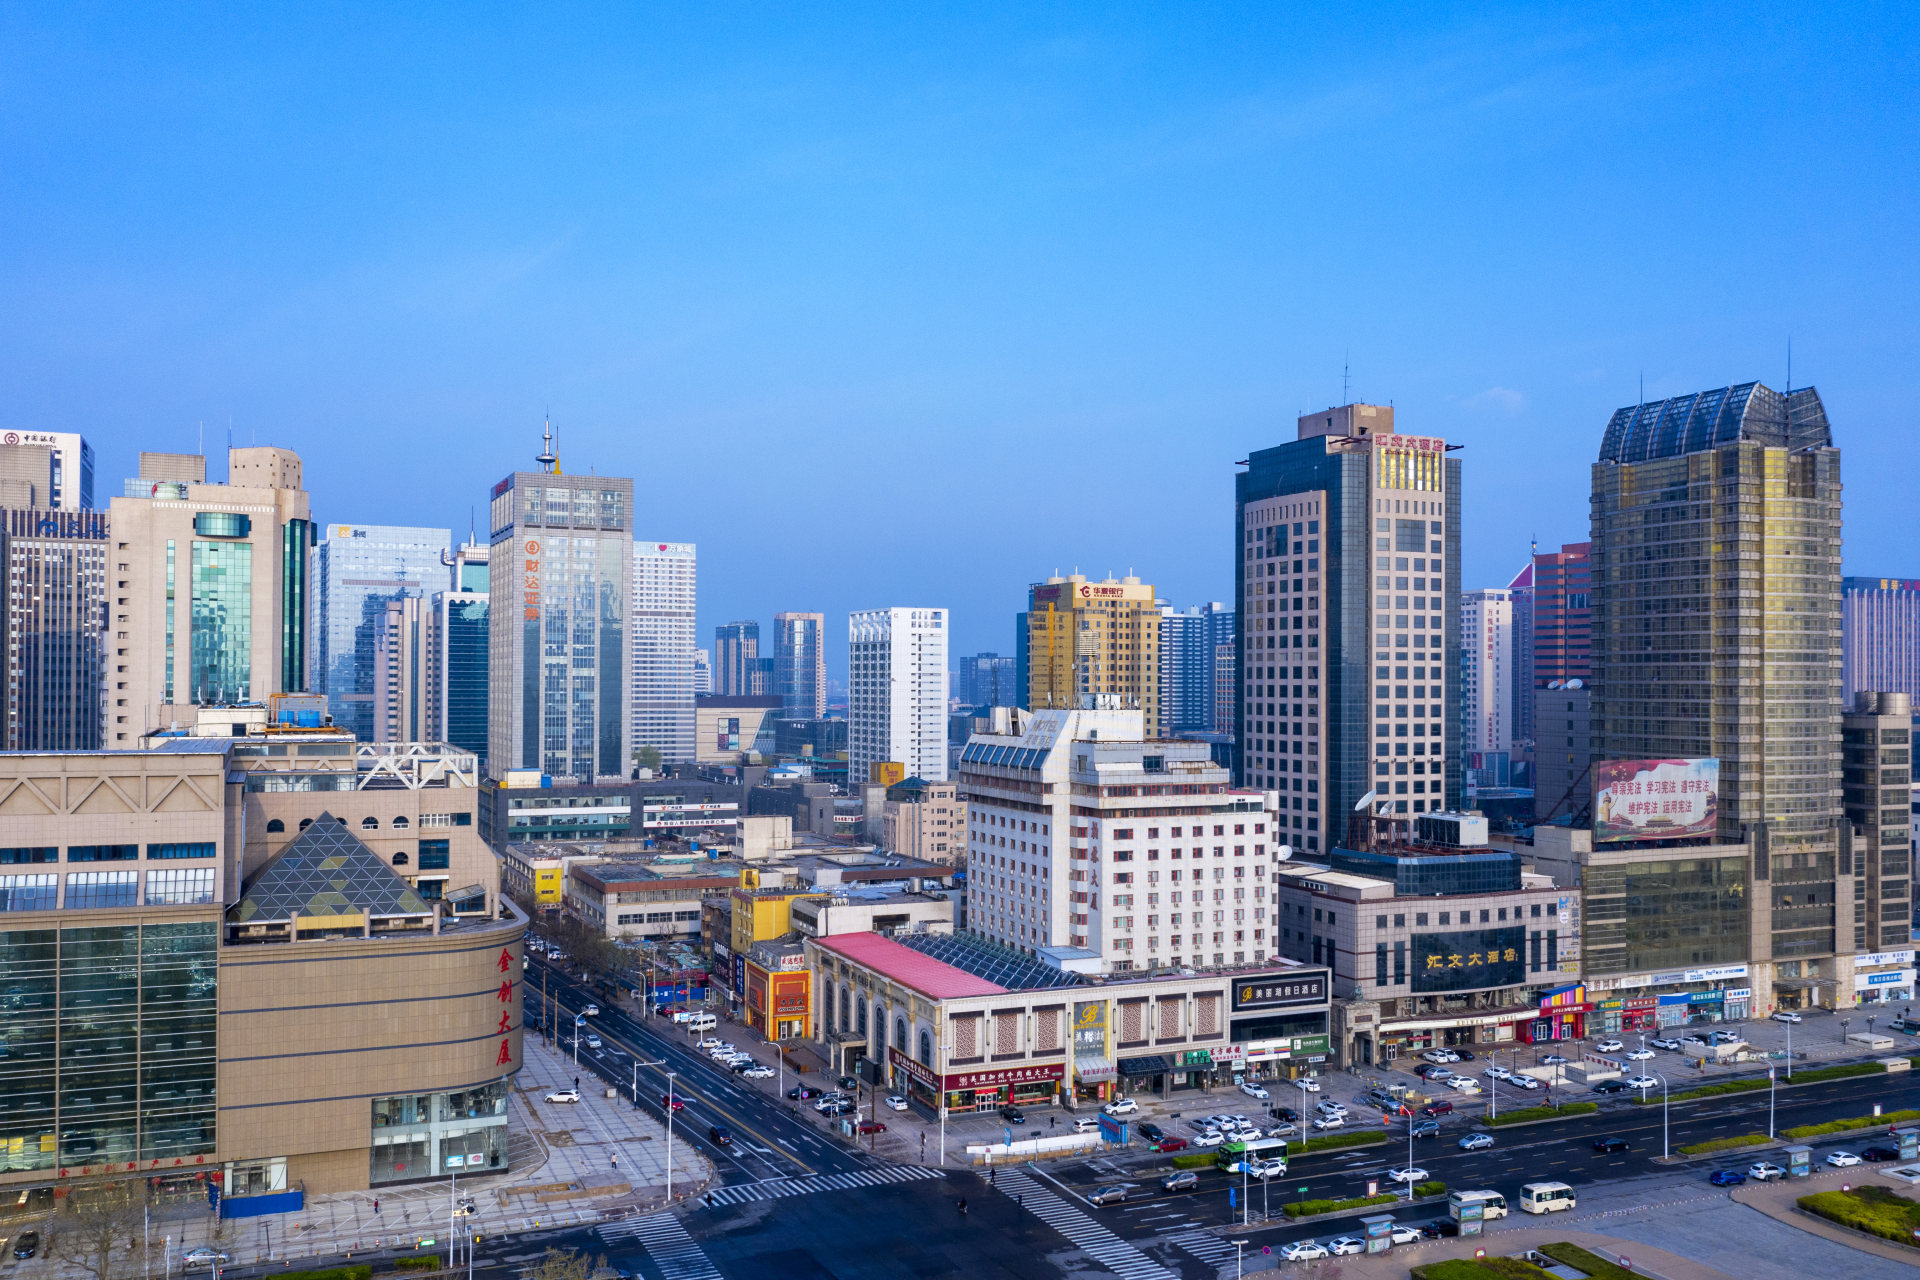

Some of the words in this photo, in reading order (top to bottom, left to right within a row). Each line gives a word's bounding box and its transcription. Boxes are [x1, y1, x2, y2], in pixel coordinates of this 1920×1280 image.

[24, 434, 56, 443] 中国银行
[1375, 434, 1443, 452] 汇文大酒店
[525, 559, 540, 621] 财达证券
[1093, 587, 1124, 595] 华夏银行
[1611, 781, 1642, 796] 尊崇宪法
[1646, 781, 1676, 794] 学习宪法
[1681, 780, 1710, 793] 遵守宪法
[1628, 801, 1658, 815] 维护宪法
[1662, 800, 1693, 814] 运用宪法
[1571, 896, 1580, 940] 儿童书城
[1427, 948, 1515, 969] 汇文大酒店
[1256, 984, 1318, 999] 美丽湖假日酒店
[497, 948, 514, 1066] 金创大厦
[1210, 1045, 1241, 1056] 东方眼镜
[60, 1155, 204, 1177] 金融创新产业园
